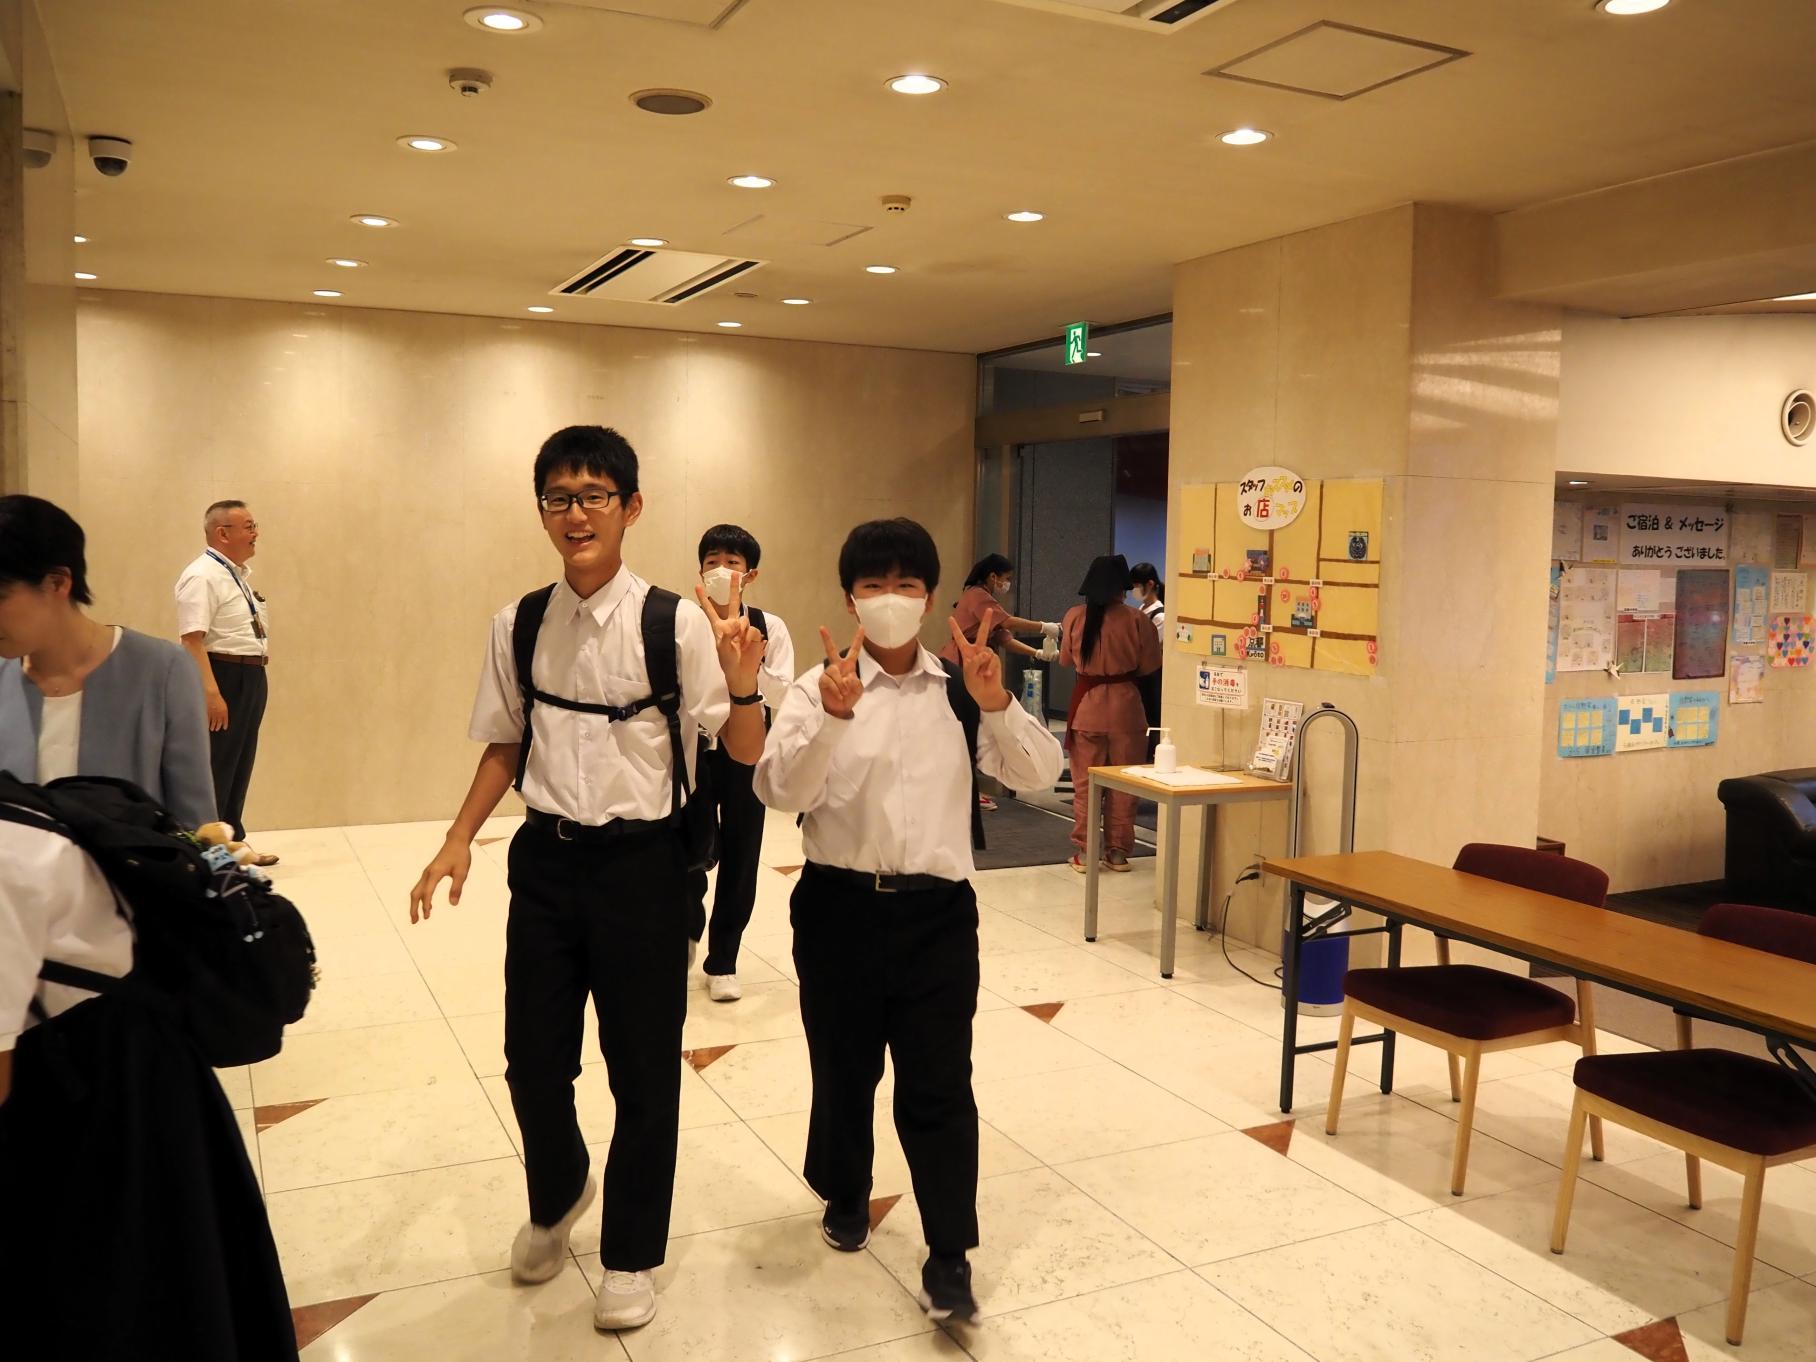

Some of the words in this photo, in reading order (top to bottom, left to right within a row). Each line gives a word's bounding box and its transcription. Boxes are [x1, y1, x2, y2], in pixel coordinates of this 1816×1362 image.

[1626, 515, 1660, 531] ご宿泊
[1664, 516, 1673, 530] &
[1679, 517, 1724, 532] メッセージ
[1632, 545, 1673, 558] ありがとう
